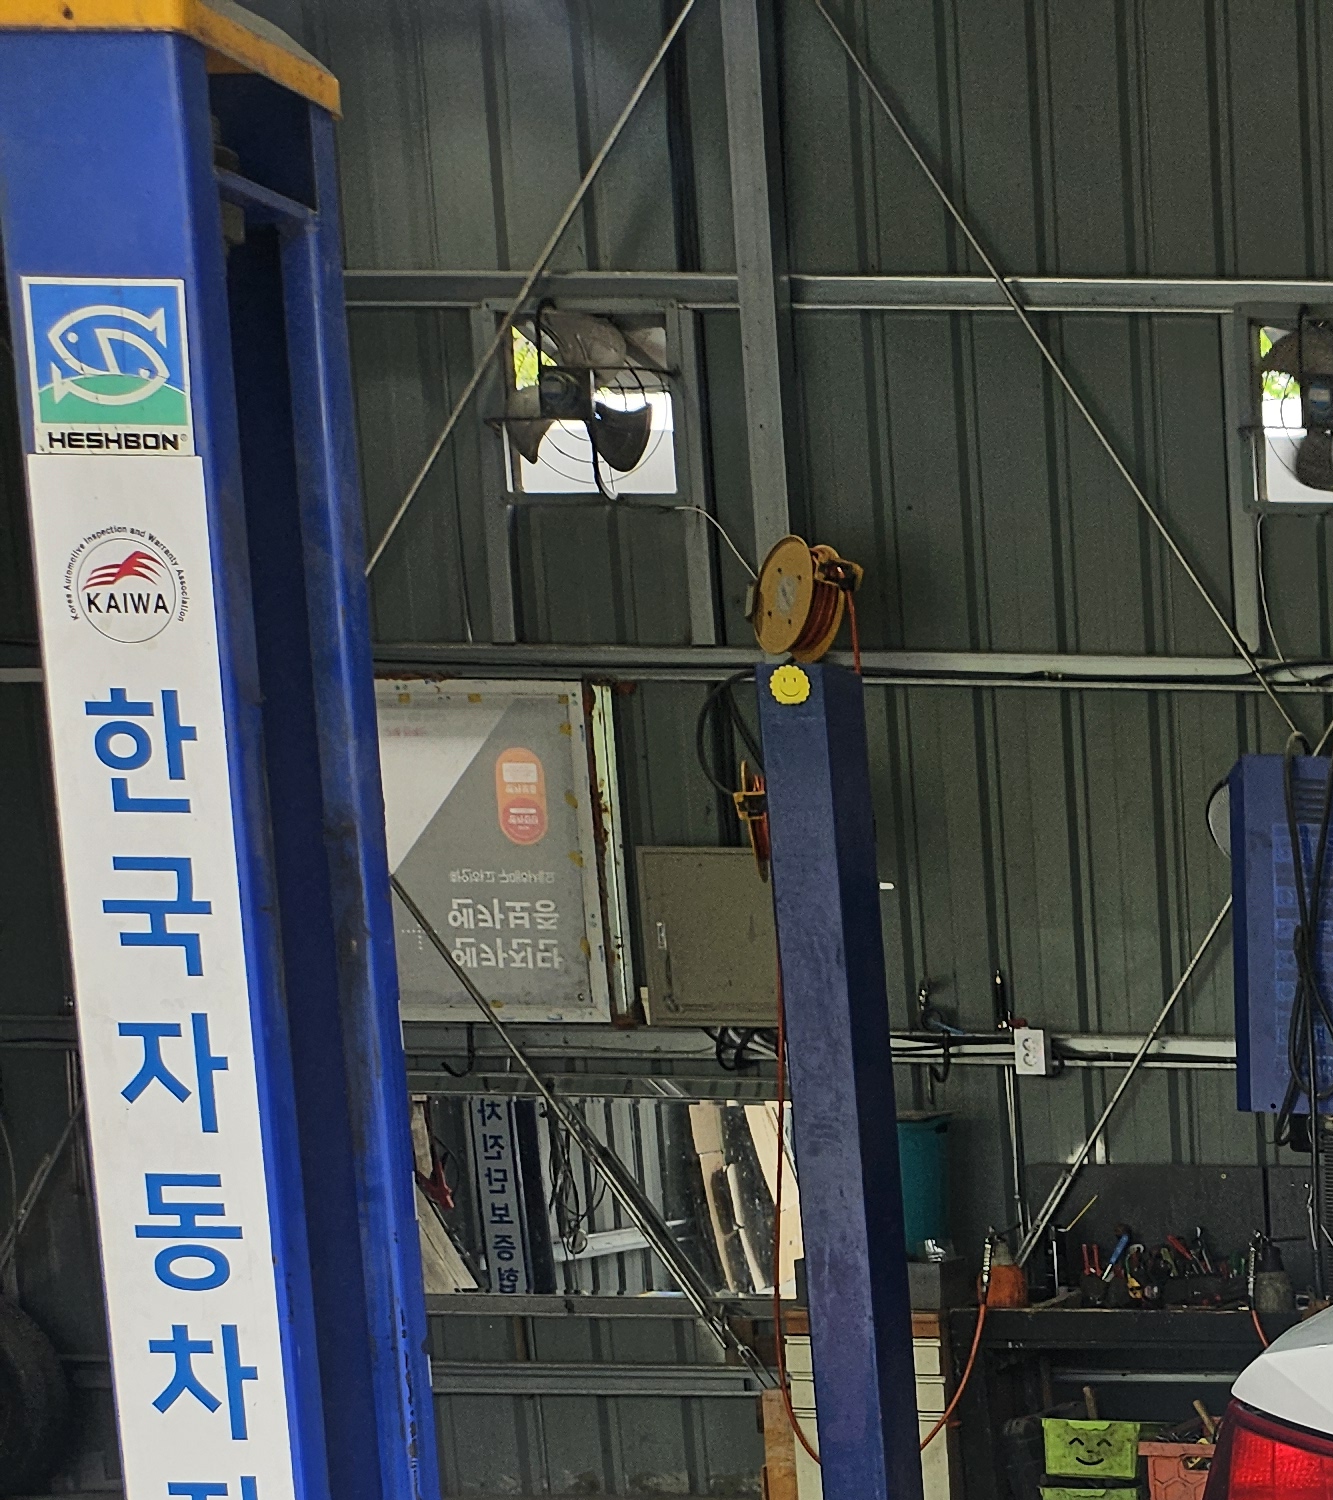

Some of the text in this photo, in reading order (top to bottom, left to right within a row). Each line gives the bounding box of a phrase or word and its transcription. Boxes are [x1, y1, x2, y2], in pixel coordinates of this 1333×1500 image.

[48, 431, 179, 450] HESHBON
[83, 526, 127, 544] Inspection
[130, 527, 146, 538] and
[86, 593, 170, 614] KAIWA
